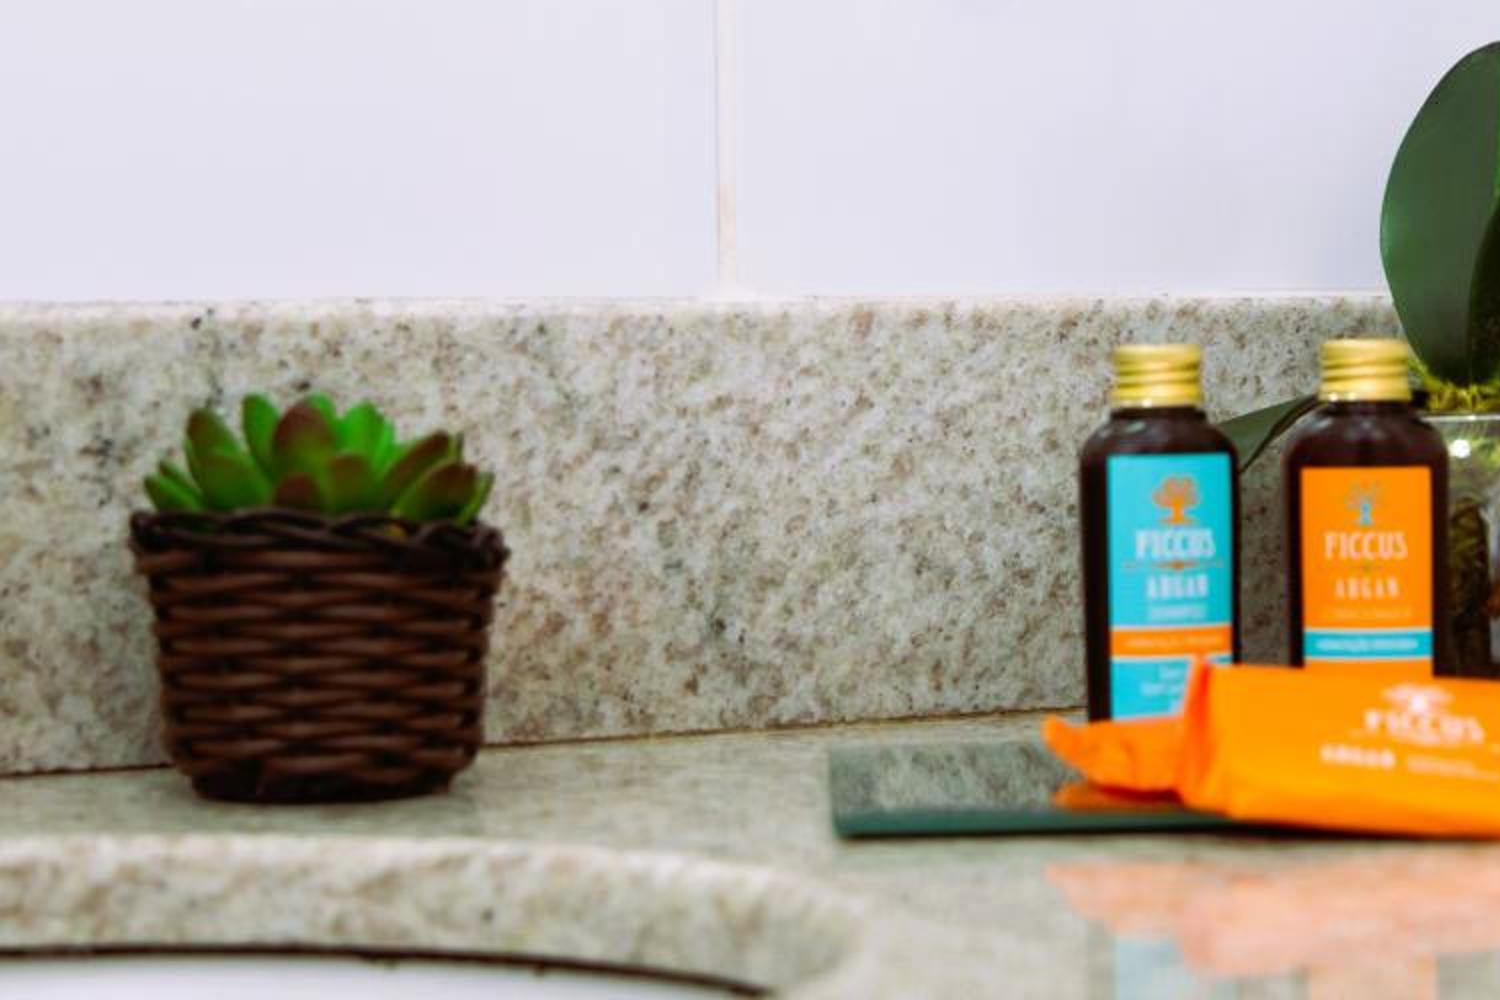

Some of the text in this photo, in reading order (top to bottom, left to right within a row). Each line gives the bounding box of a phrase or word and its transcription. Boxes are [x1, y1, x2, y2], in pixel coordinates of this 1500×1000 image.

[1135, 529, 1215, 559] FICCUS
[1324, 531, 1408, 559] FICCUS
[1335, 577, 1400, 599] ARGAN
